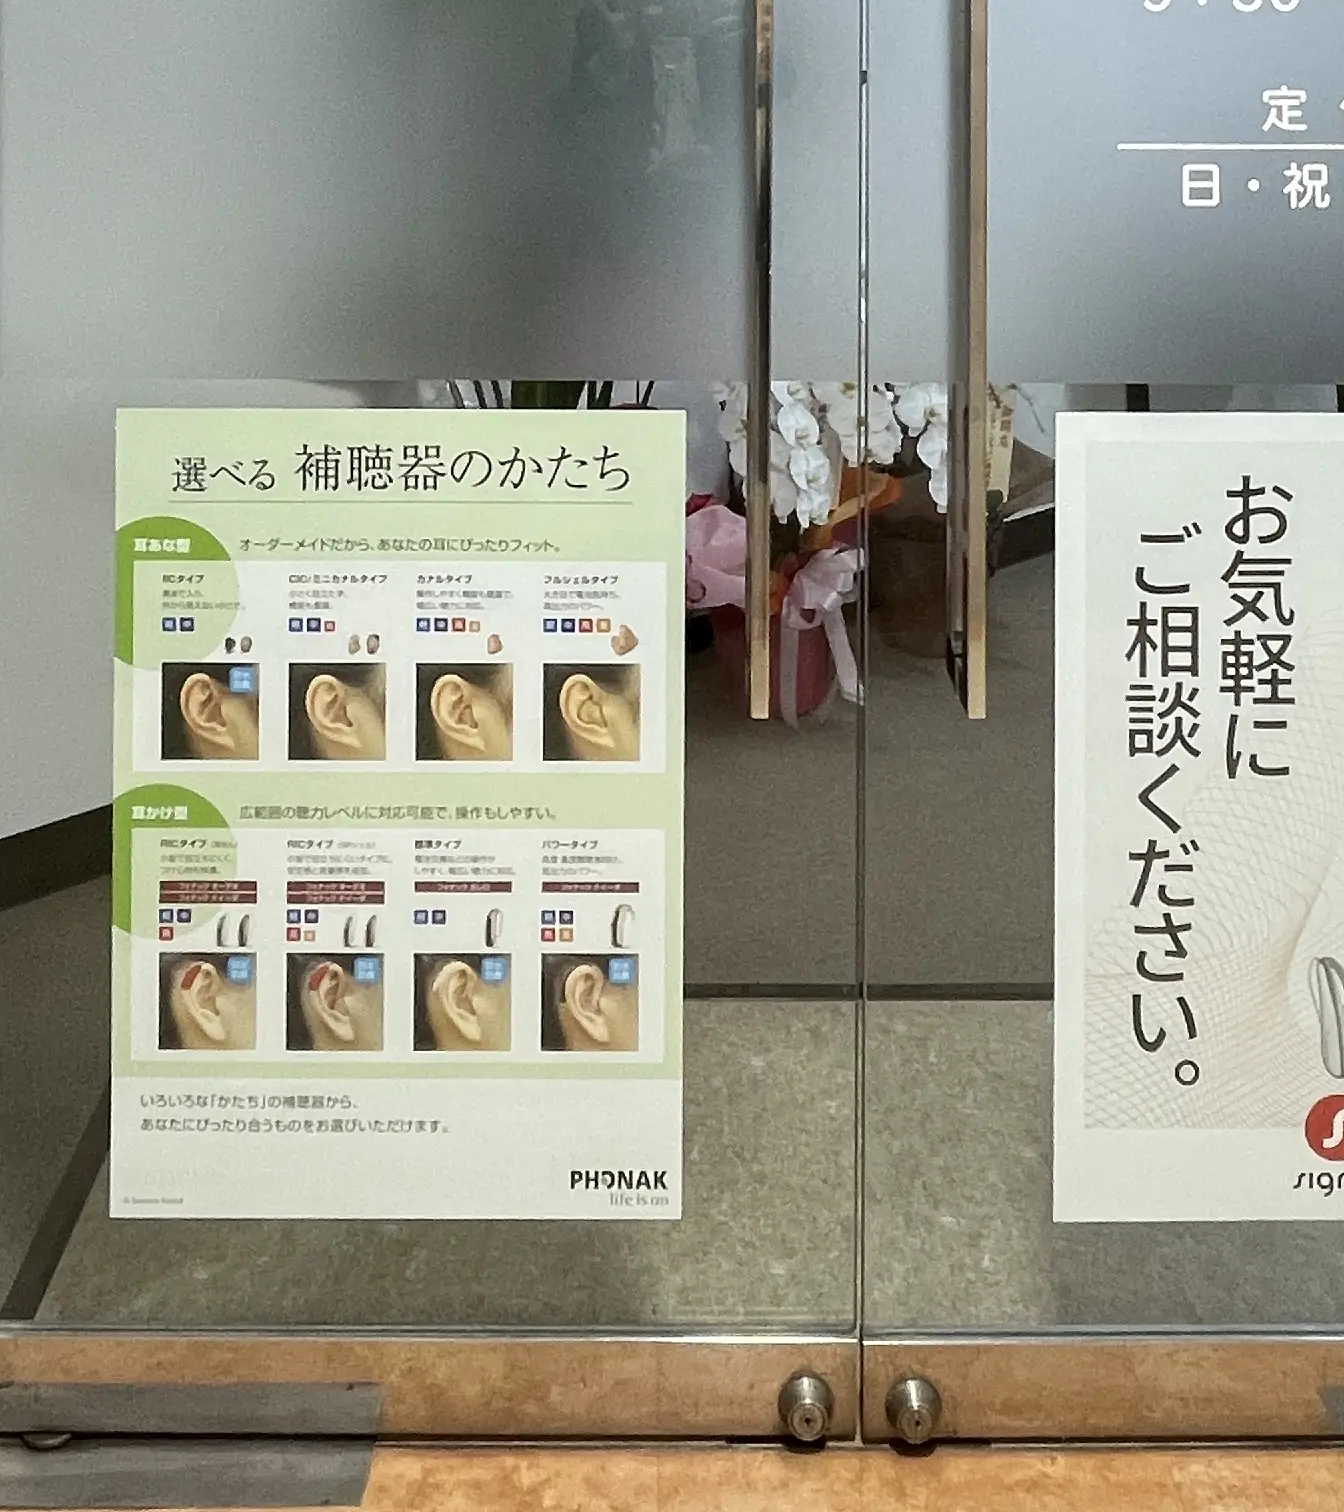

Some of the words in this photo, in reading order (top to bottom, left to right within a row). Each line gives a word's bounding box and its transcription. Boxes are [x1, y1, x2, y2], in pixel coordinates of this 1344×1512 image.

[170, 456, 277, 492] 選べる
[294, 443, 632, 492] 補聴器のかたち
[1219, 474, 1296, 780] お気軽に
[1124, 521, 1202, 1086] ご相談ください。
[570, 1169, 669, 1190] PHONAK
[609, 1192, 634, 1206] life
[636, 1192, 648, 1206] is
